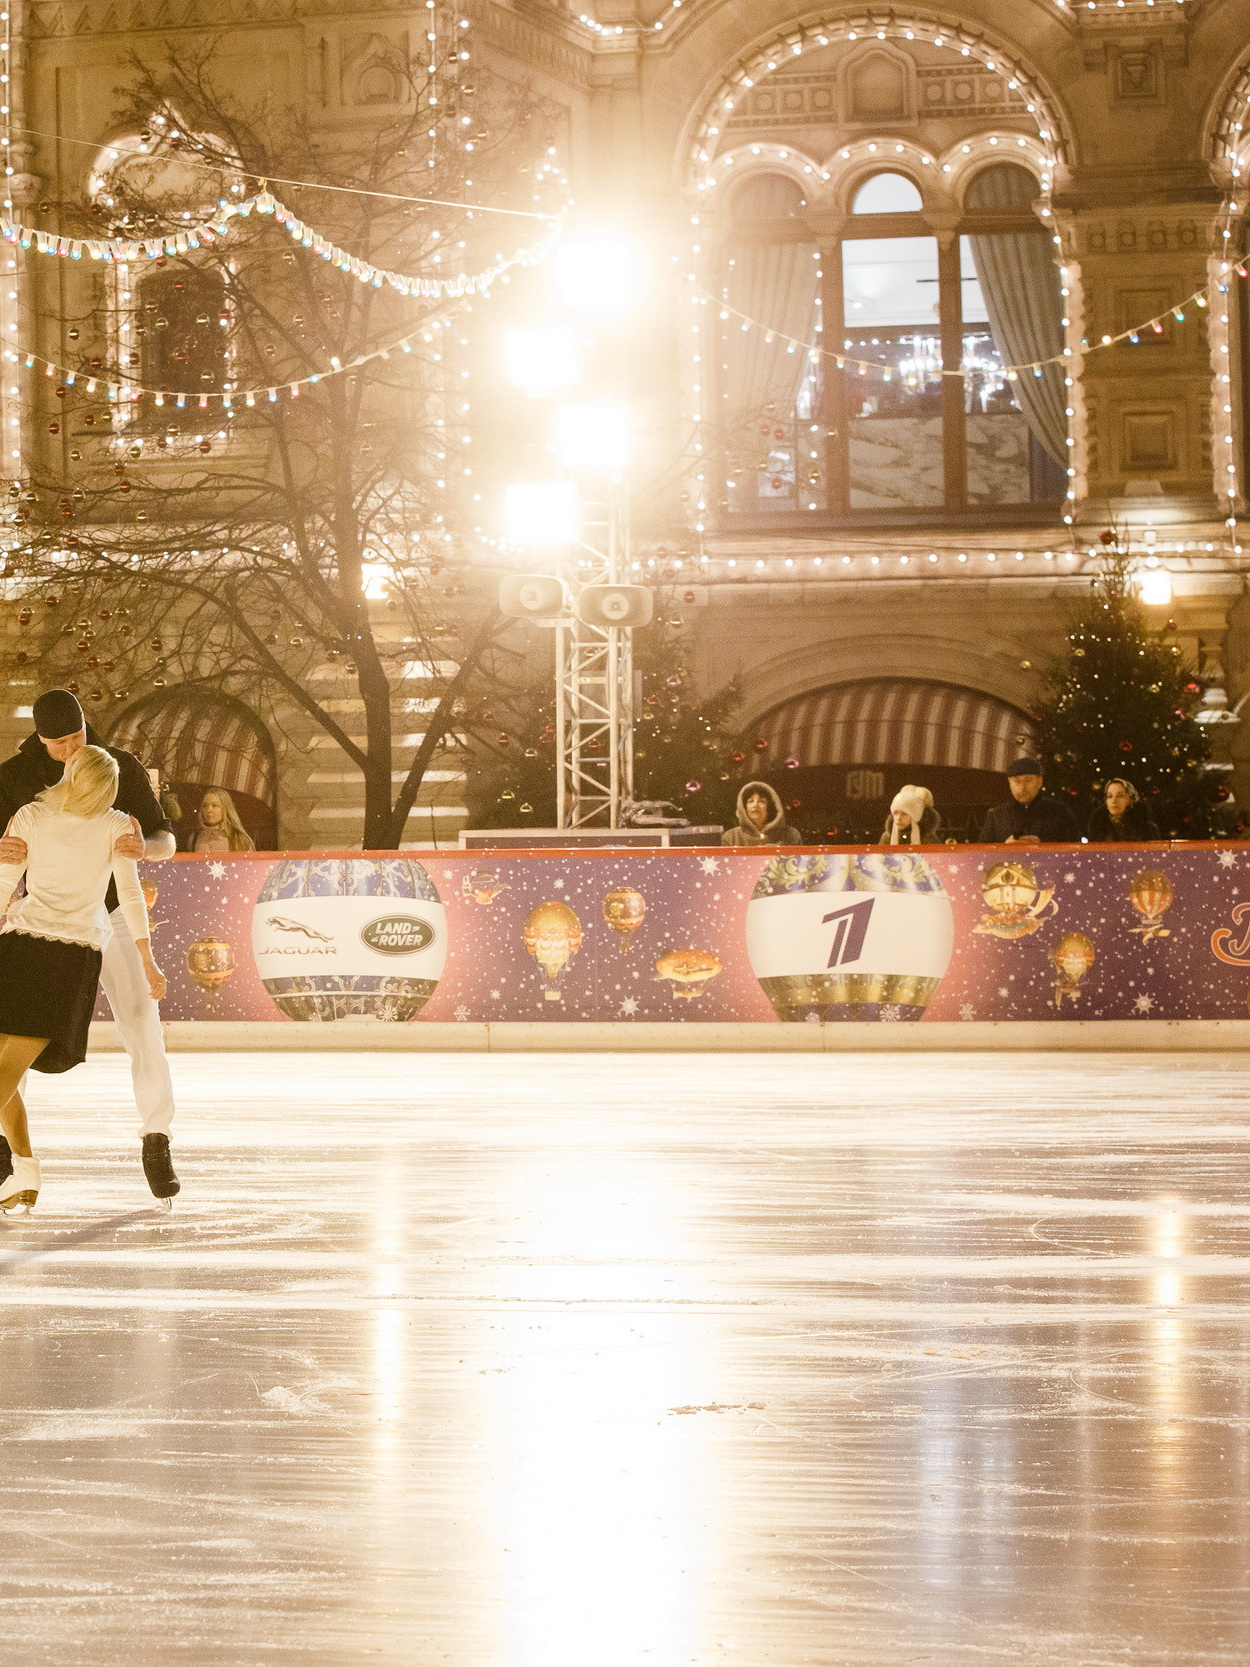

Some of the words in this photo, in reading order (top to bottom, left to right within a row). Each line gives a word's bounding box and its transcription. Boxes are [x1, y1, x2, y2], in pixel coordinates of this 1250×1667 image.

[375, 922, 414, 934] LAND
[378, 934, 424, 946] ROVER
[258, 946, 339, 955] JAGUAR
